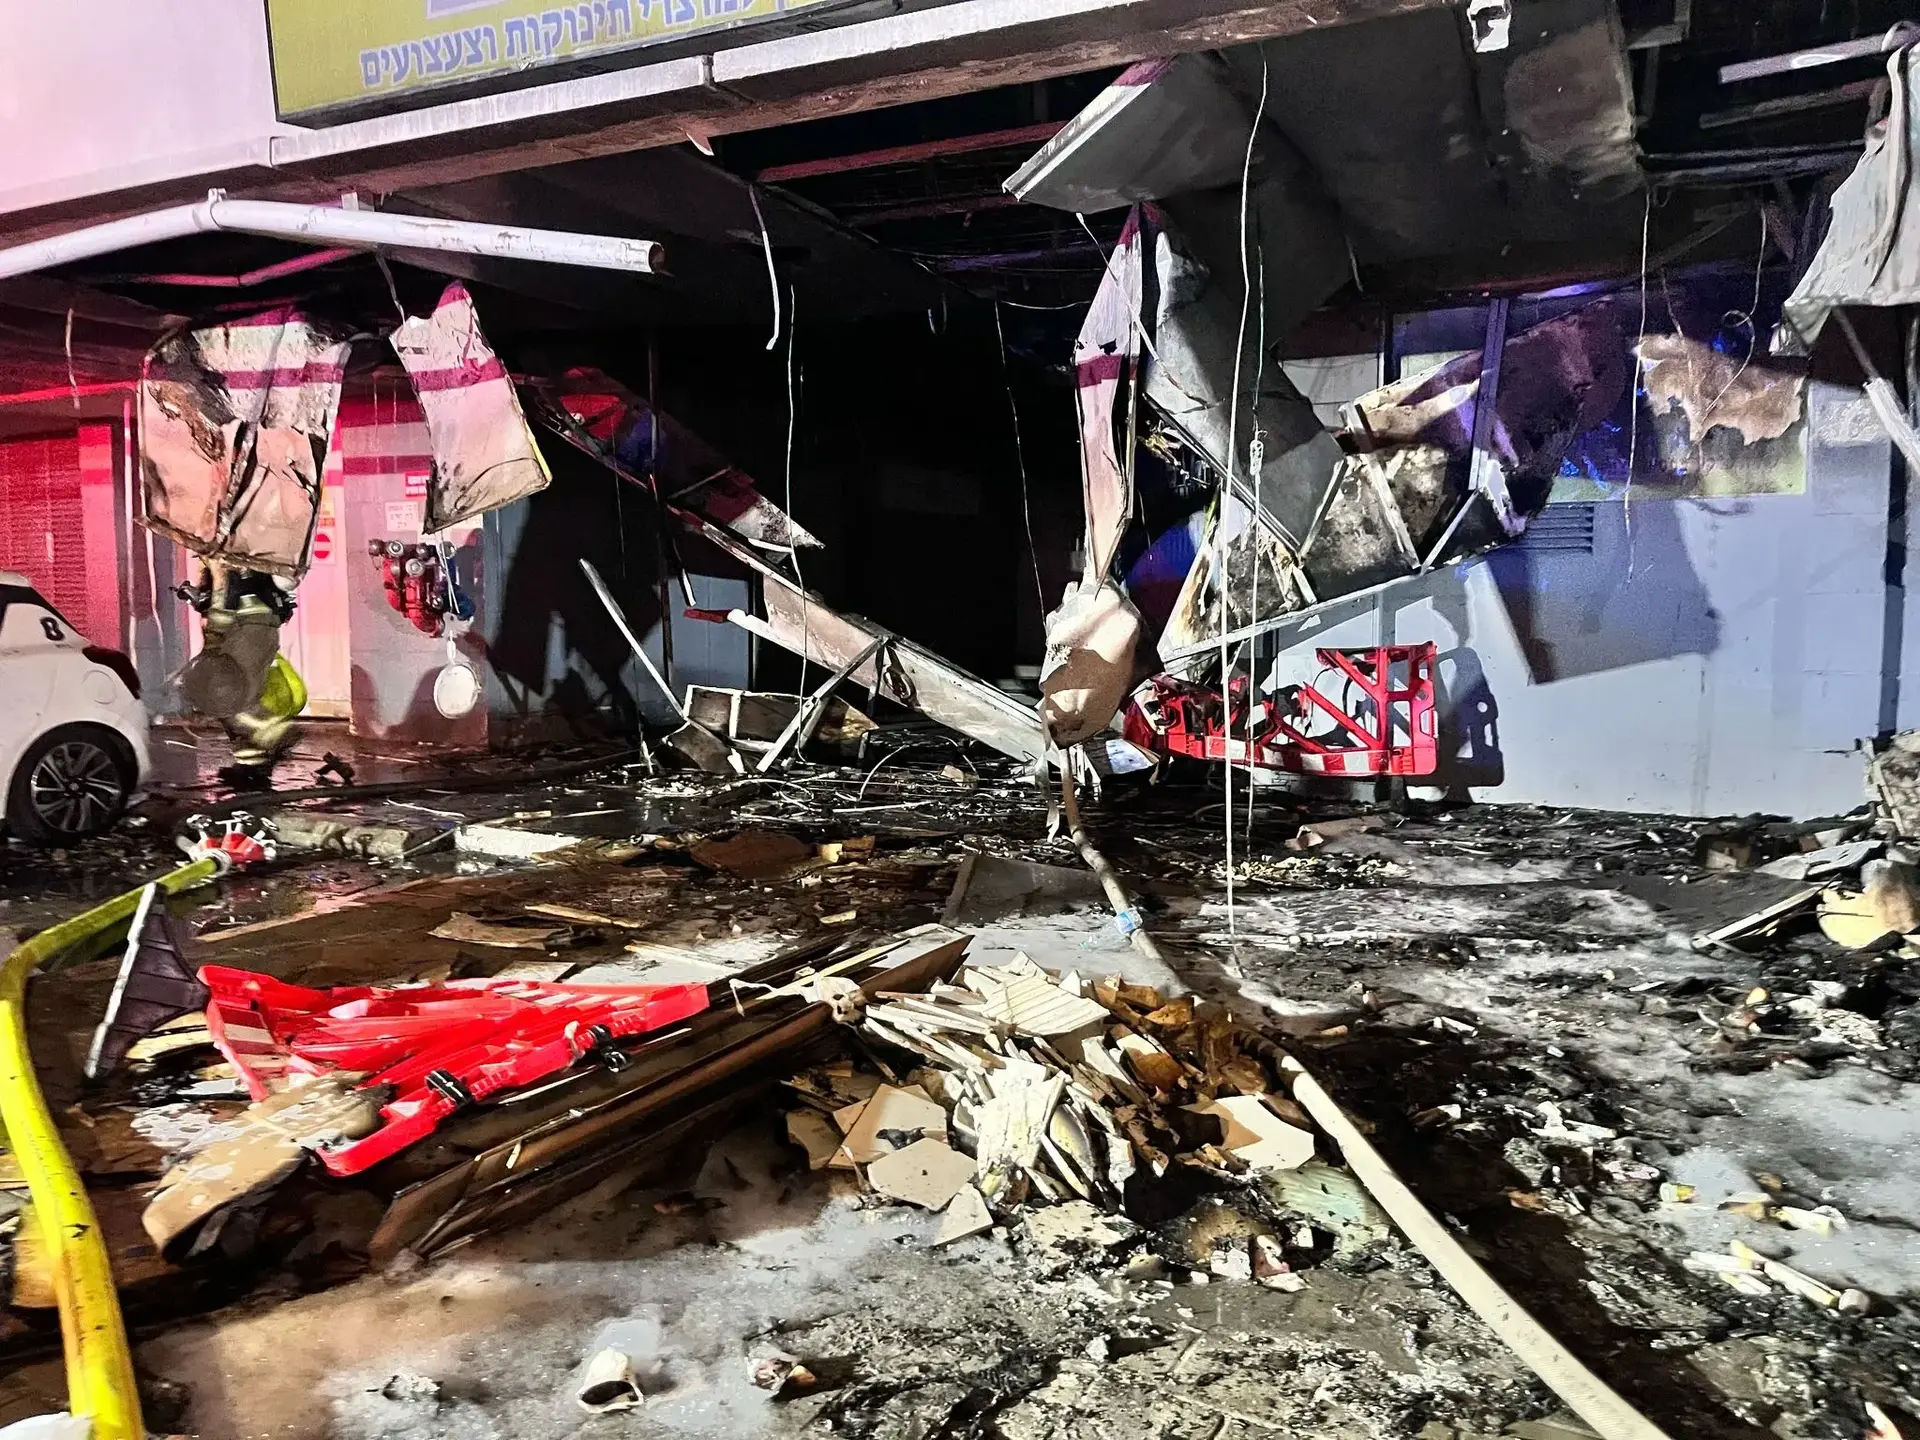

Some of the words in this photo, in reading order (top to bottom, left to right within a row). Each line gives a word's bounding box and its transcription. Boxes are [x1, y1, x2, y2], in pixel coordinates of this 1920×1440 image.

[359, 25, 497, 88] וצעצועים
[504, 0, 632, 58] תינוקות
[40, 616, 65, 641] 8
